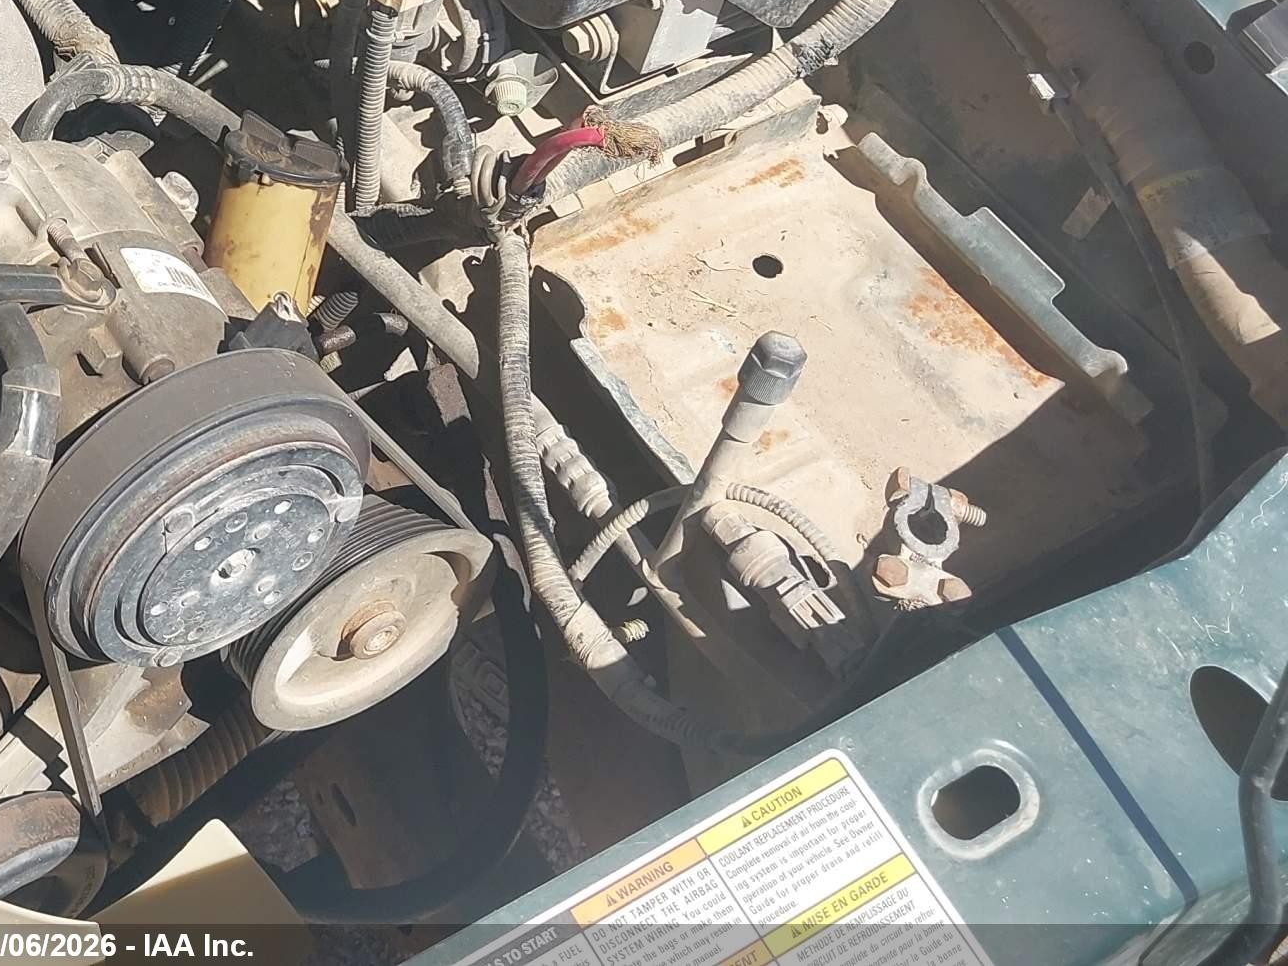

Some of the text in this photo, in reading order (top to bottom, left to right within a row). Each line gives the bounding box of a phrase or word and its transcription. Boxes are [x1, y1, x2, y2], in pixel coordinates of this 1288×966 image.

[718, 785, 849, 866] COOLANT REPLACEMENT PROCEDURE
[751, 785, 802, 821] CAUTION
[726, 854, 761, 880] Complete
[760, 836, 790, 858] removal
[798, 826, 809, 836] air
[809, 815, 827, 829] from
[825, 808, 838, 819] the
[838, 796, 857, 812] cool-
[734, 878, 749, 893] ing
[749, 861, 779, 884] system
[788, 832, 827, 860] important
[827, 824, 839, 835] for
[840, 809, 867, 829] proper
[741, 877, 779, 904] operation
[787, 862, 805, 878] your
[833, 834, 848, 847] See
[848, 819, 874, 838] Owner
[616, 860, 673, 900] WARNING
[749, 829, 882, 915] Guide for proper drain and refill
[801, 872, 888, 930] MISE EN GARDE
[591, 867, 711, 941] DO NOT TAMPER WITH OR
[599, 878, 718, 954] DISCONNECT THE AIRBAG
[607, 939, 644, 966] SYSTEM
[683, 906, 700, 921] You
[701, 891, 726, 910] could
[642, 949, 656, 962] the
[657, 936, 680, 955] bags
[680, 931, 688, 940] or
[690, 916, 712, 934] make
[713, 903, 733, 920] them
[833, 927, 845, 938] DE
[844, 894, 897, 931] REMPLISSAGE
[896, 887, 909, 899] DU
[836, 942, 848, 954] DE
[847, 900, 916, 946] REFROIDISSEMENT
[502, 947, 522, 965] TO
[520, 926, 559, 955] START
[558, 943, 582, 962] FUEL
[666, 944, 692, 964] which
[693, 936, 710, 950] may
[709, 921, 732, 939] result
[898, 938, 915, 953] pour
[922, 919, 944, 936] bonne
[919, 937, 942, 955] Guide
